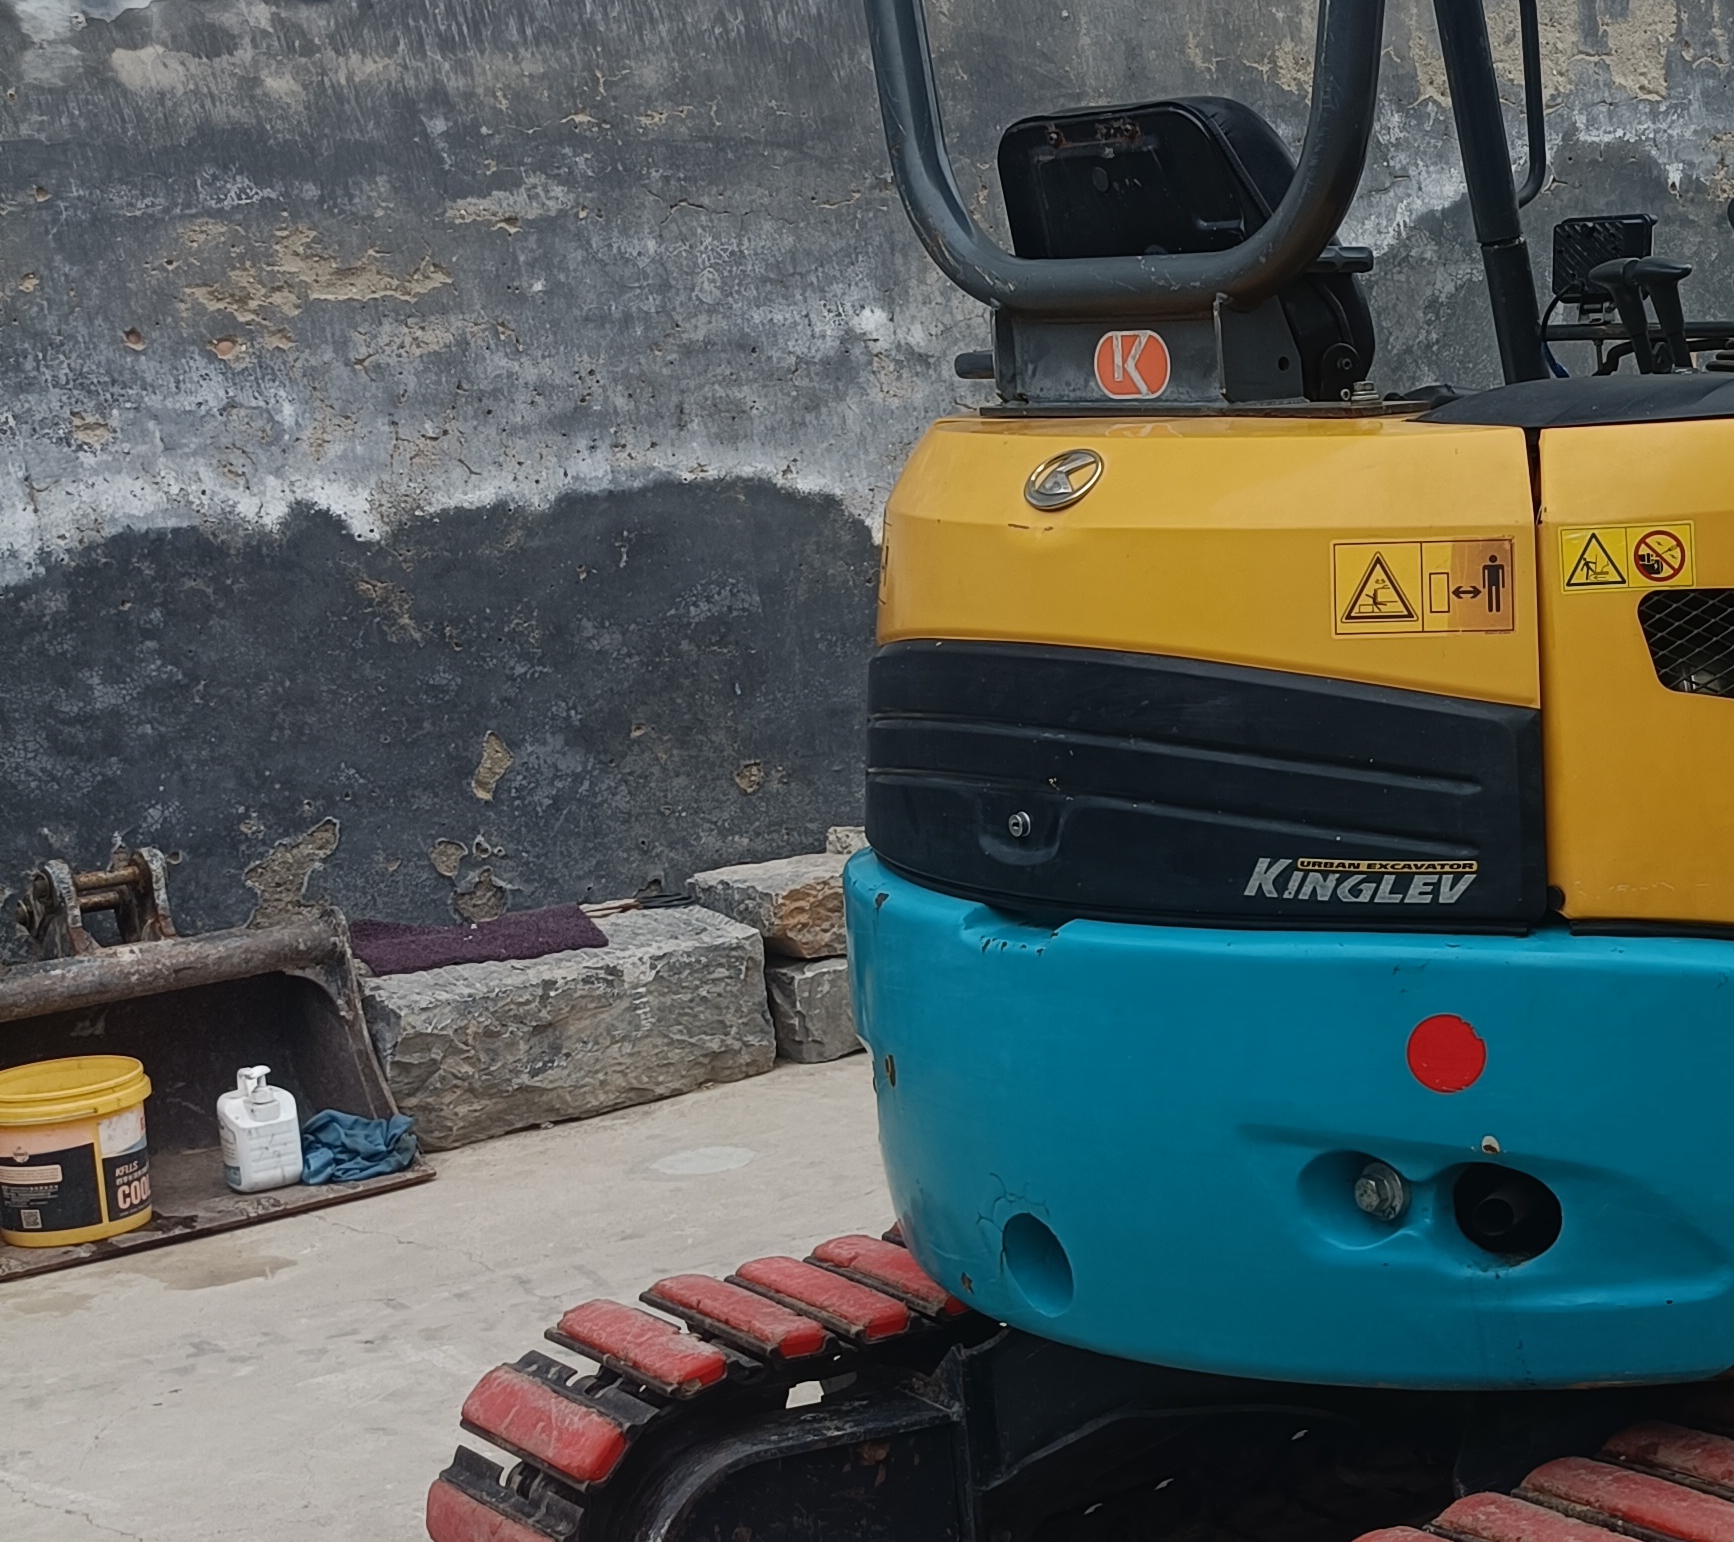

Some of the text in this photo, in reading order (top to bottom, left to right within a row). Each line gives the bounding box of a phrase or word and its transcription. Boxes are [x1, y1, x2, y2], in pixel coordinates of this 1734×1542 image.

[1300, 860, 1475, 871] URBAN EXCAVATOR
[1243, 857, 1478, 904] KINGLEV
